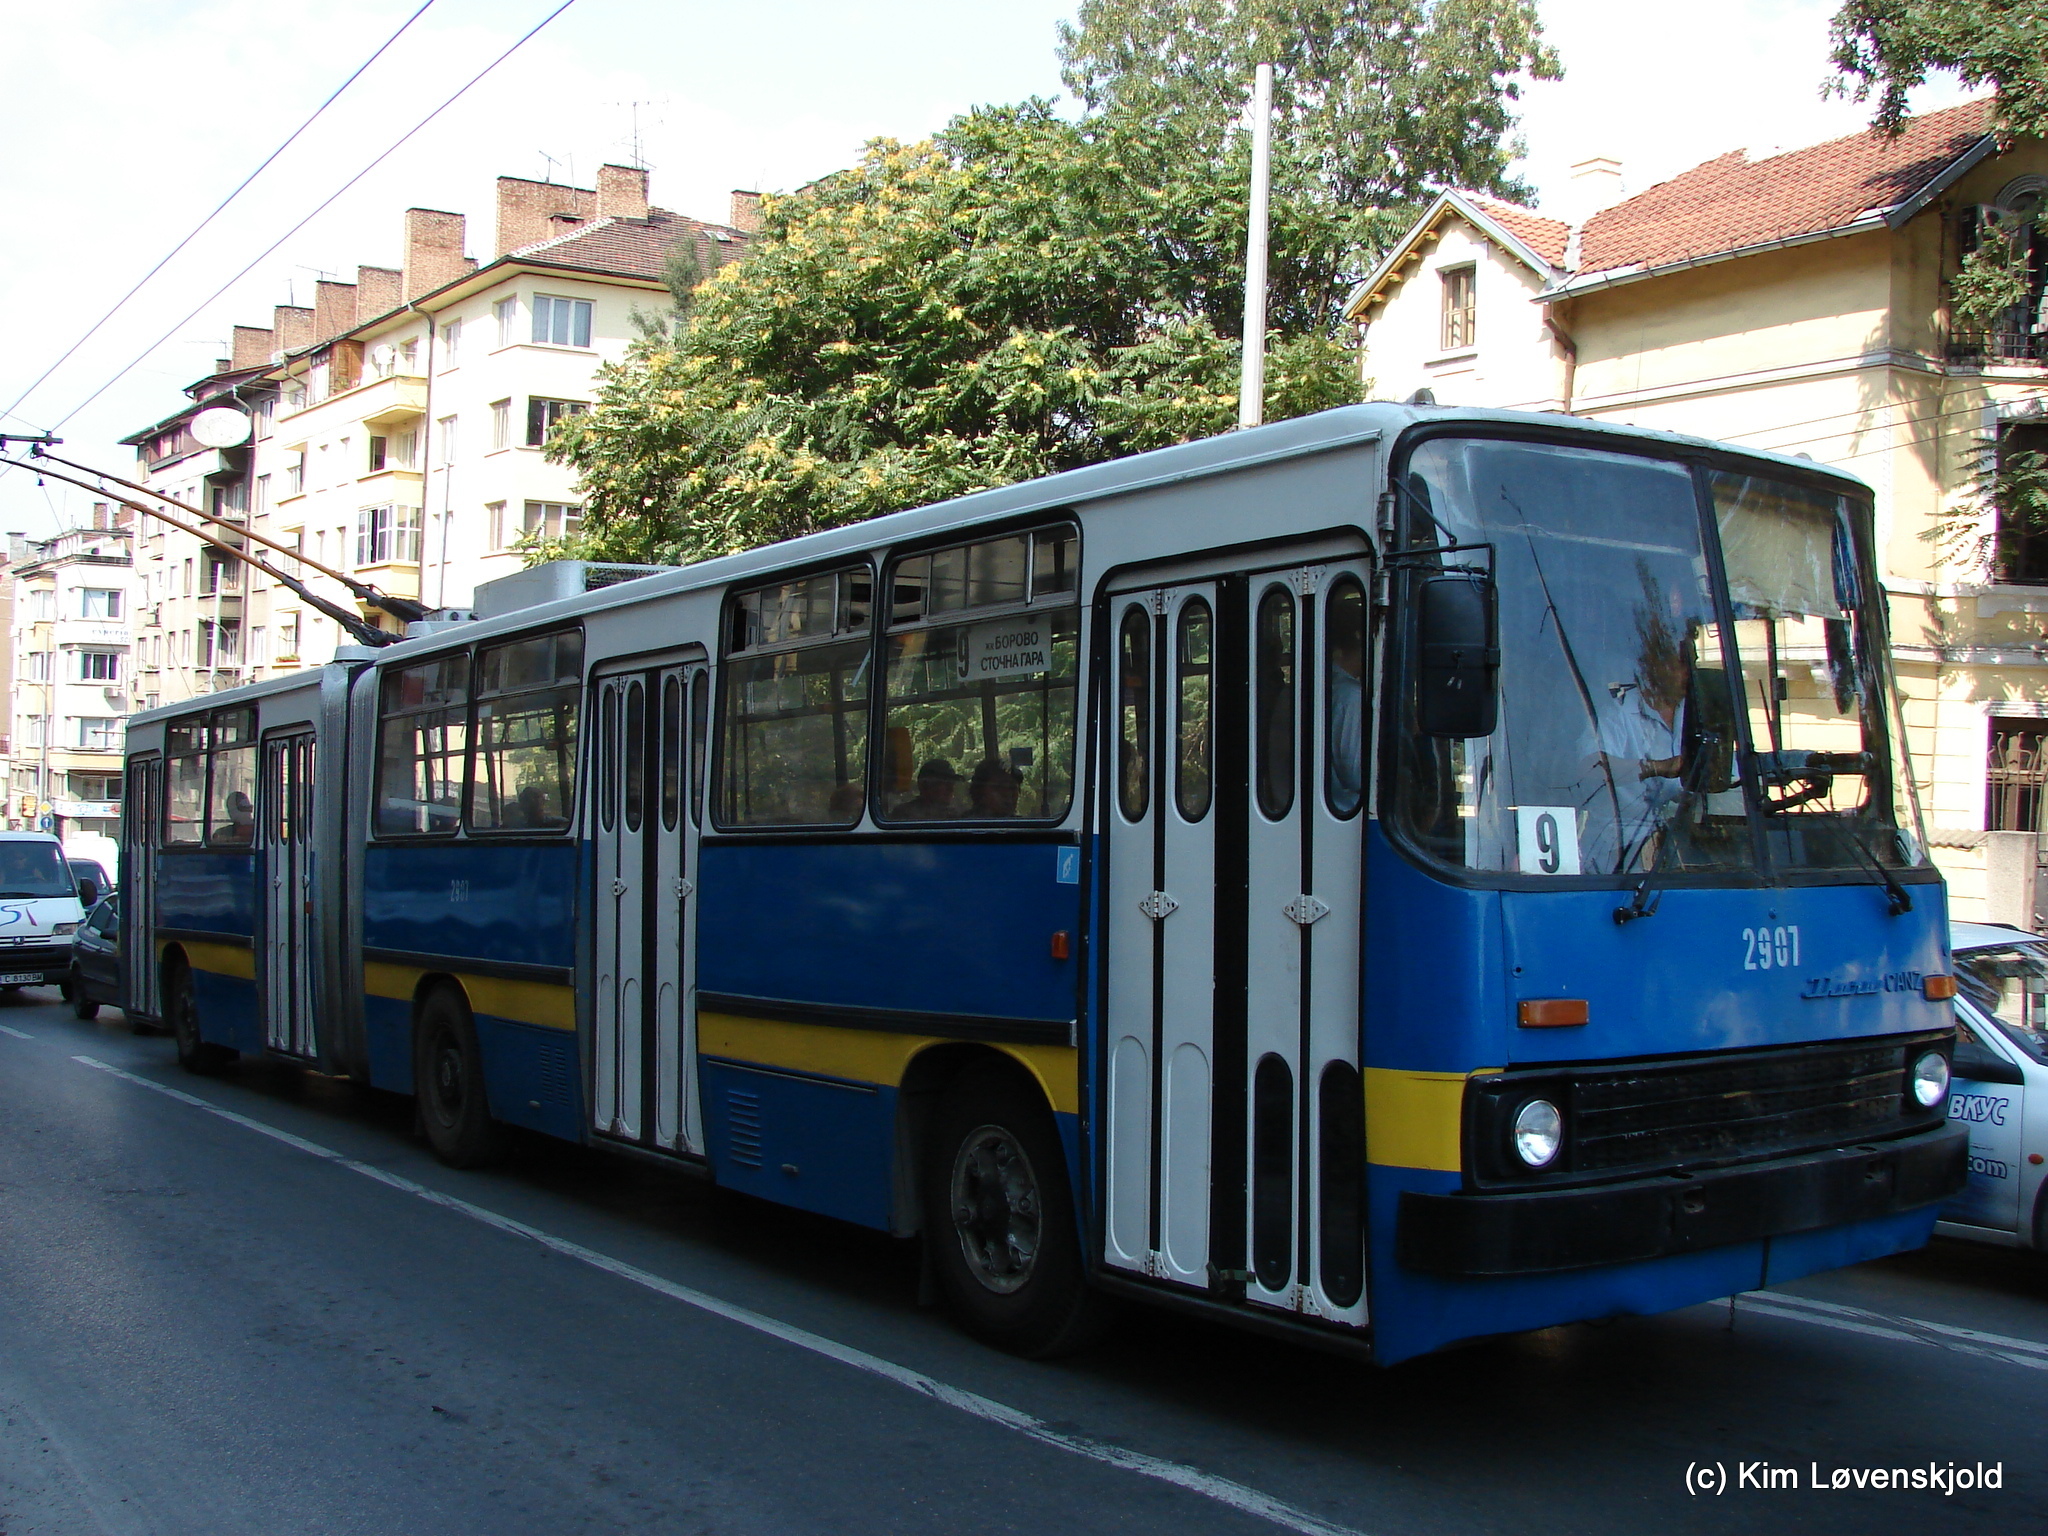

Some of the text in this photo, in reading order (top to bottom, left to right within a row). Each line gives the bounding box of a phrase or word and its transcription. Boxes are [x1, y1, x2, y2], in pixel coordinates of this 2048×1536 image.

[957, 632, 970, 678] 9
[994, 631, 1039, 650] БОРОВО
[980, 650, 1045, 672] СТОЧНА ГАРА
[1535, 810, 1560, 874] 9
[1742, 925, 1799, 971] 2907
[1947, 1093, 2009, 1126] ВКУС
